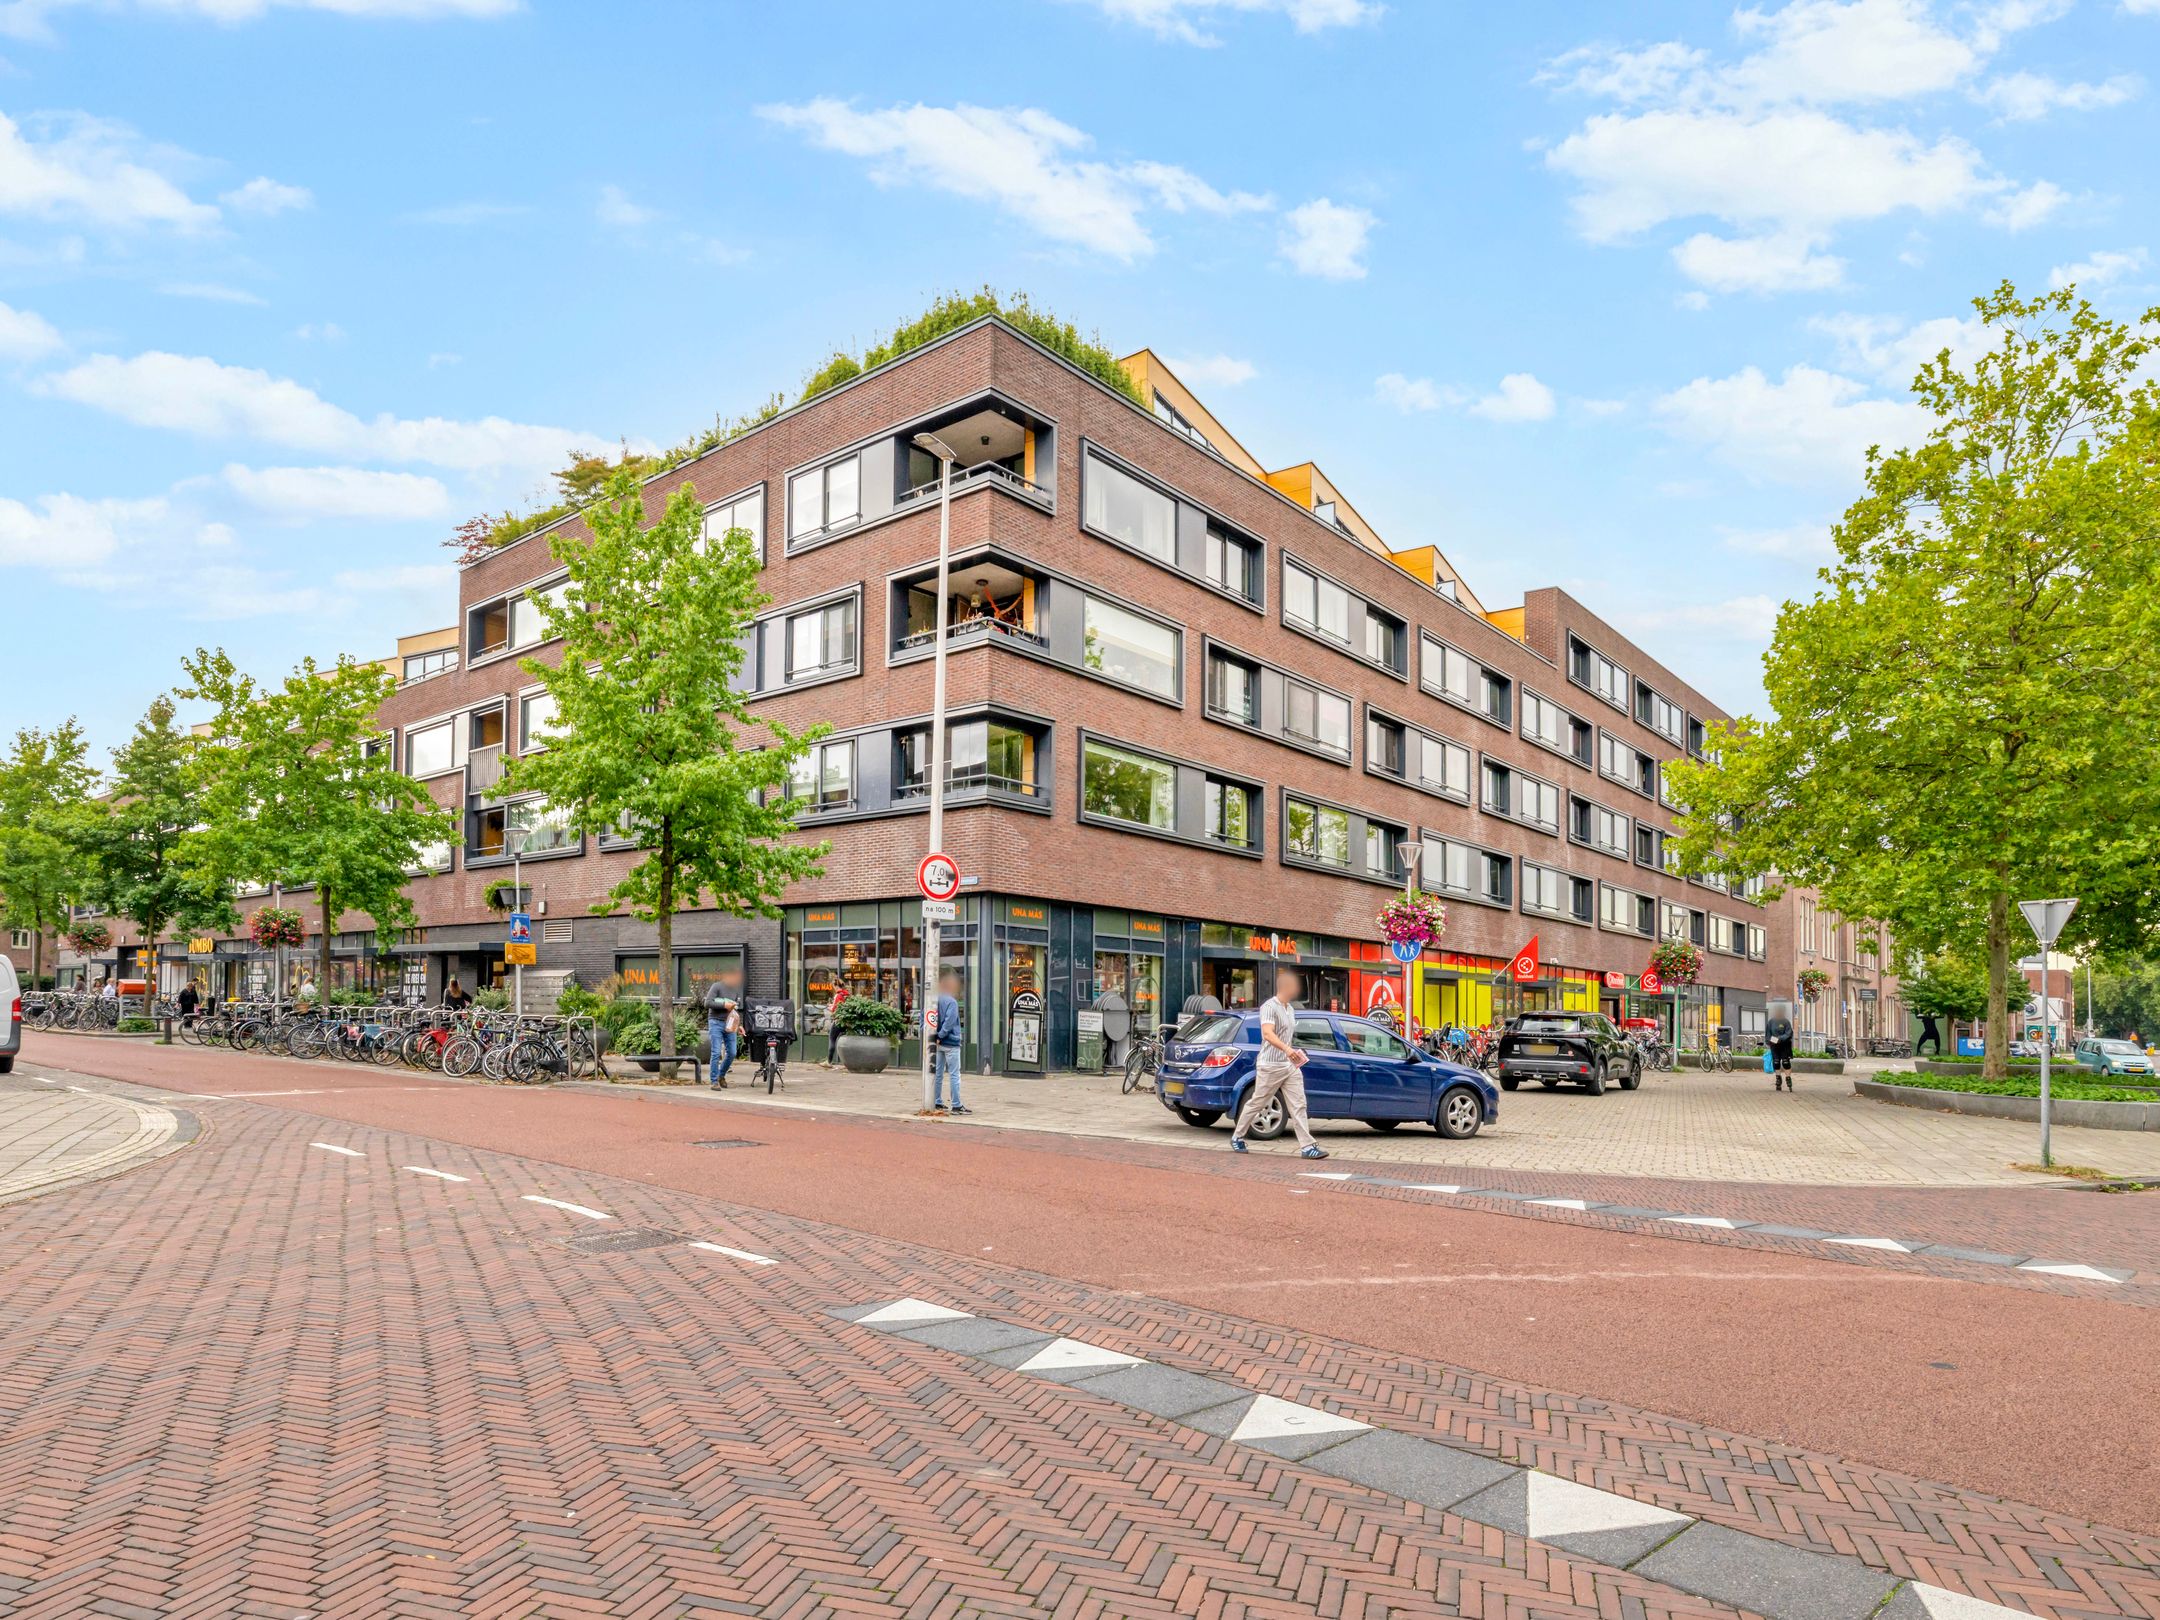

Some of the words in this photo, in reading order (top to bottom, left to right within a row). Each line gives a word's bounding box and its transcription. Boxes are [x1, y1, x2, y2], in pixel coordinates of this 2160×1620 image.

[808, 913, 820, 921] UNA
[1012, 907, 1027, 918] UNA
[1133, 920, 1146, 931] UNA
[188, 937, 214, 954] JUMBO
[1249, 936, 1272, 952] UNA
[1277, 936, 1297, 955] MÁS
